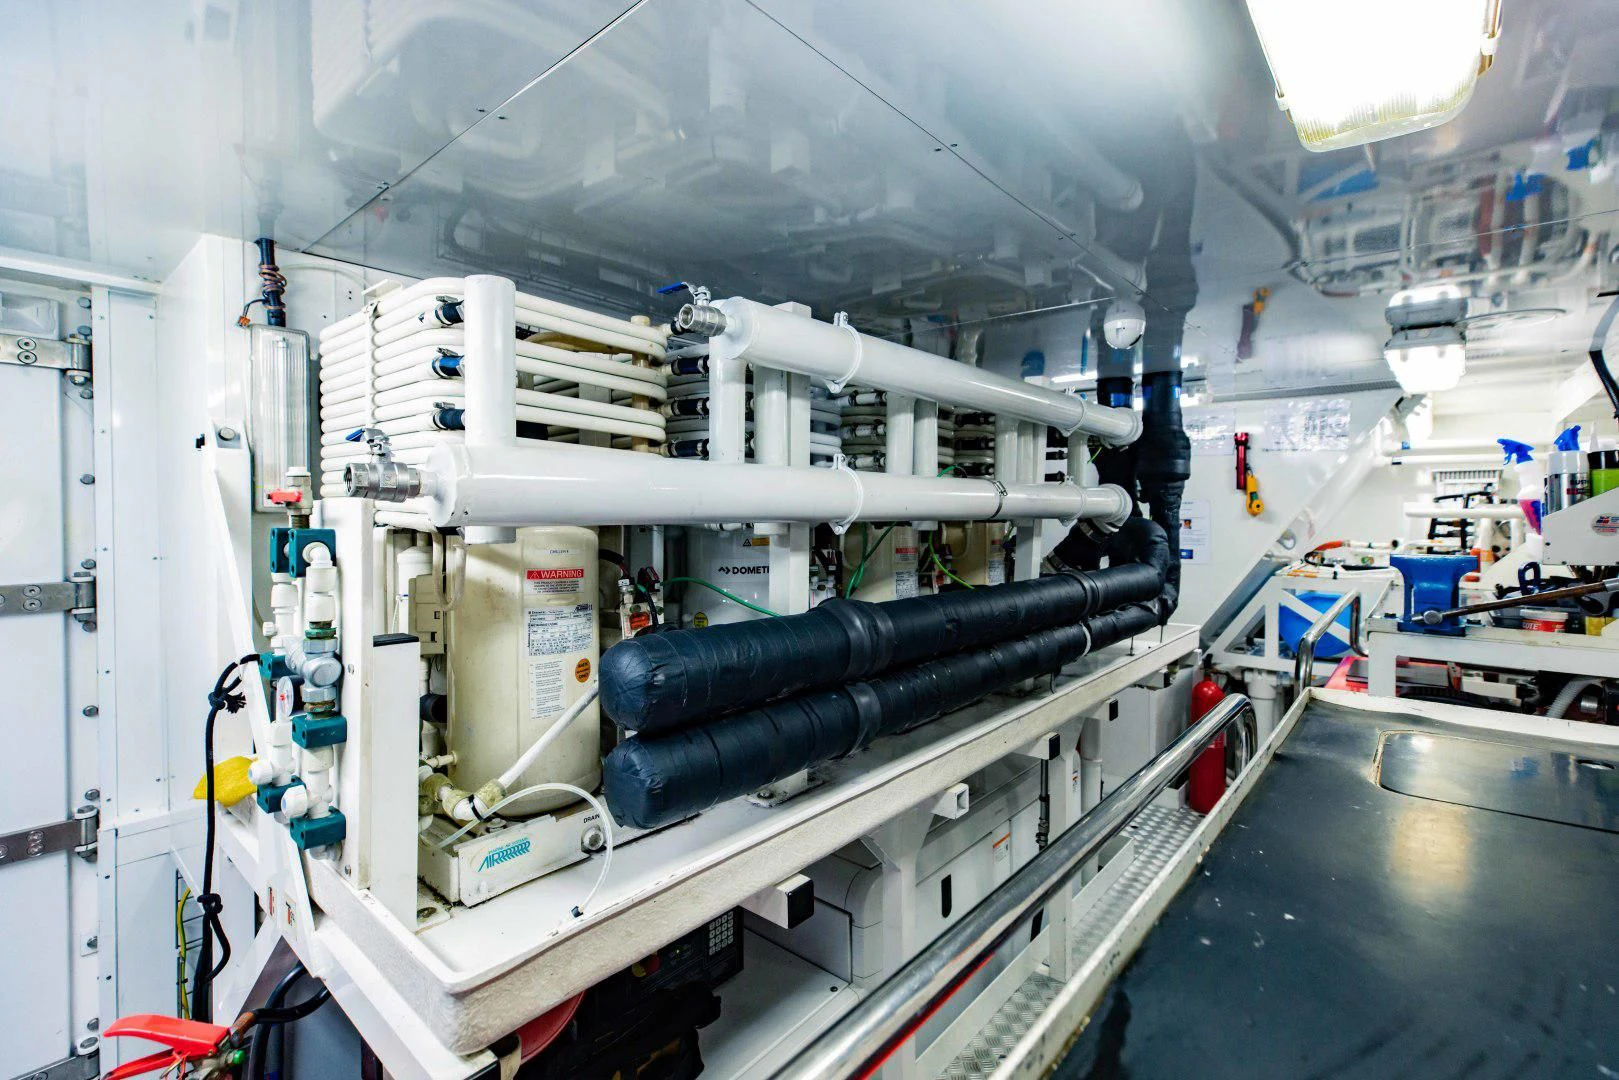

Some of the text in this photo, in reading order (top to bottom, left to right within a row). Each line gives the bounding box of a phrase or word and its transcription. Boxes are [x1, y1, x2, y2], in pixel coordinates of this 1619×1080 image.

[541, 570, 582, 579] WARNING
[732, 566, 769, 575] DOMETI
[583, 813, 600, 824] DRAIN
